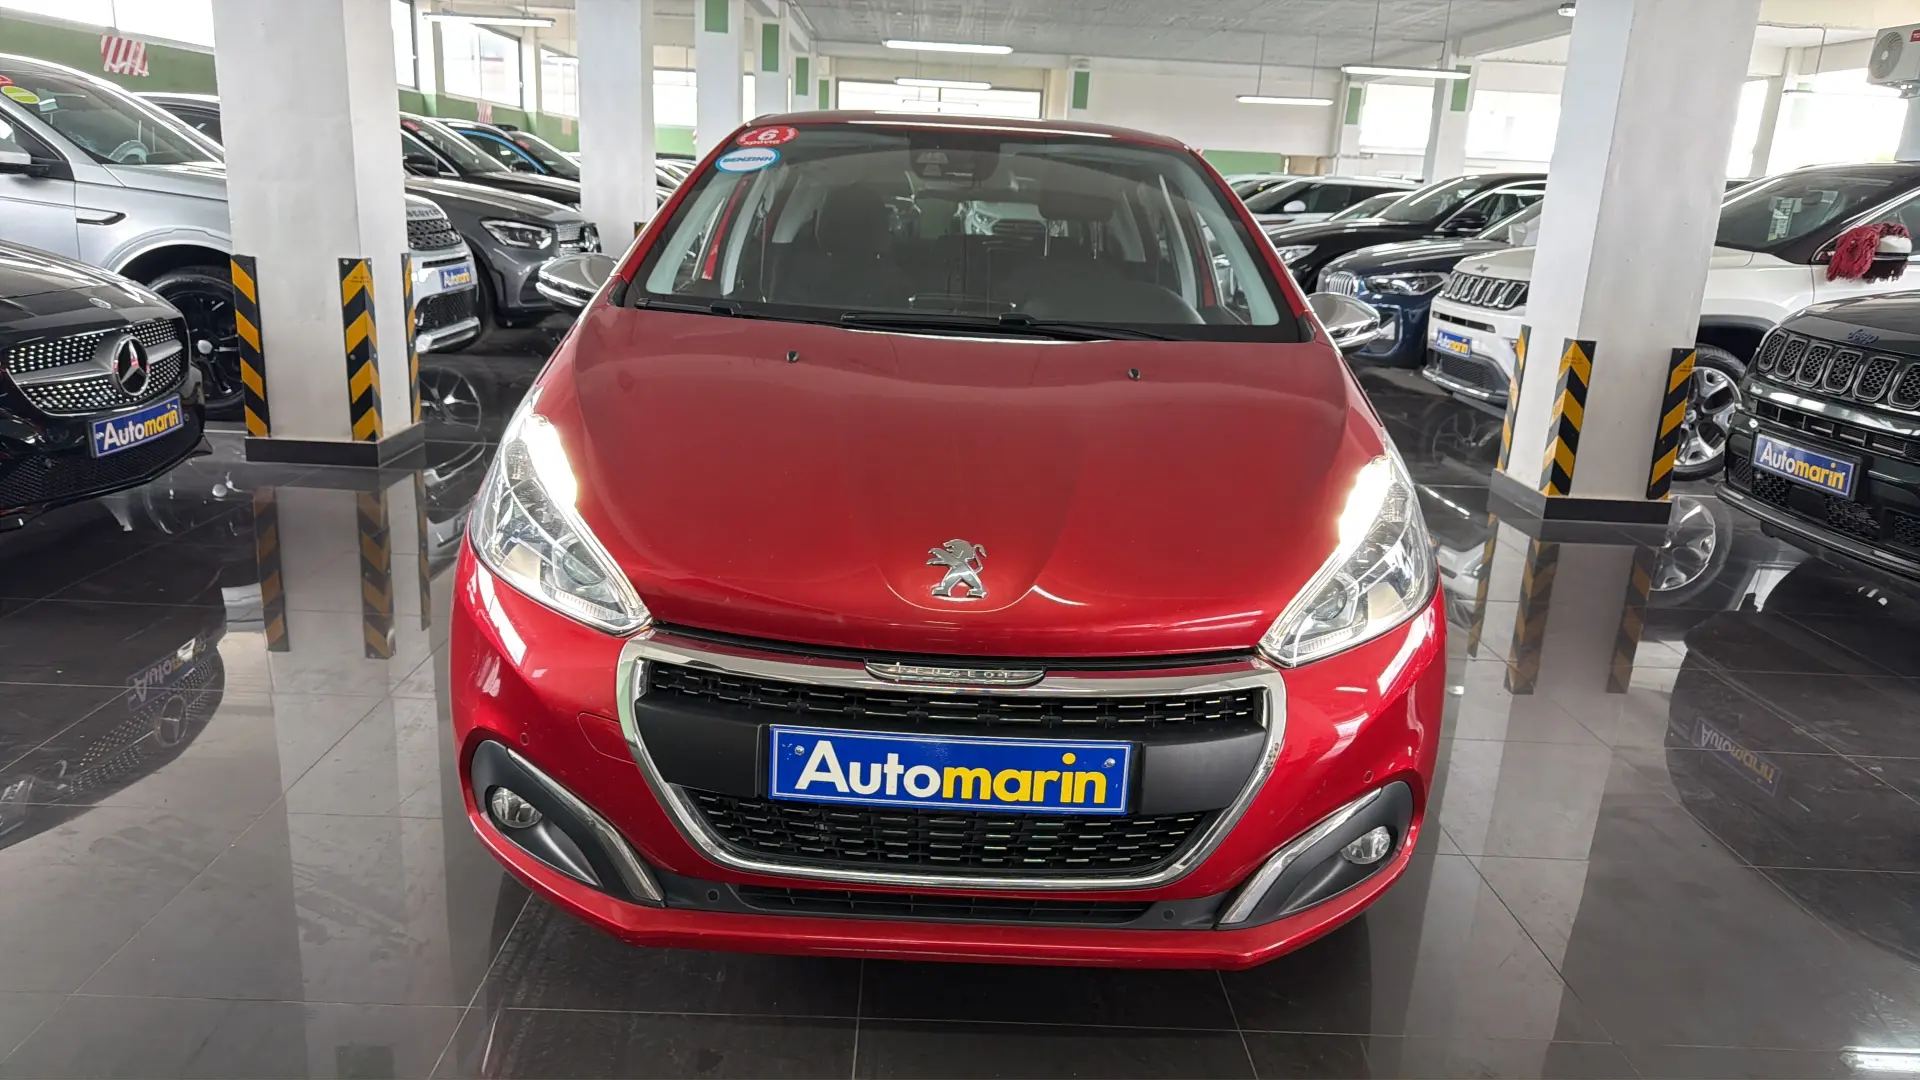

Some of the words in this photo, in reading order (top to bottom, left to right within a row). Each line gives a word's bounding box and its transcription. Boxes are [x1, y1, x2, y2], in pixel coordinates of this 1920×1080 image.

[757, 129, 779, 141] 6
[104, 403, 179, 451] Automarin
[1759, 441, 1847, 490] Automarin
[794, 740, 1107, 804] Automarin
